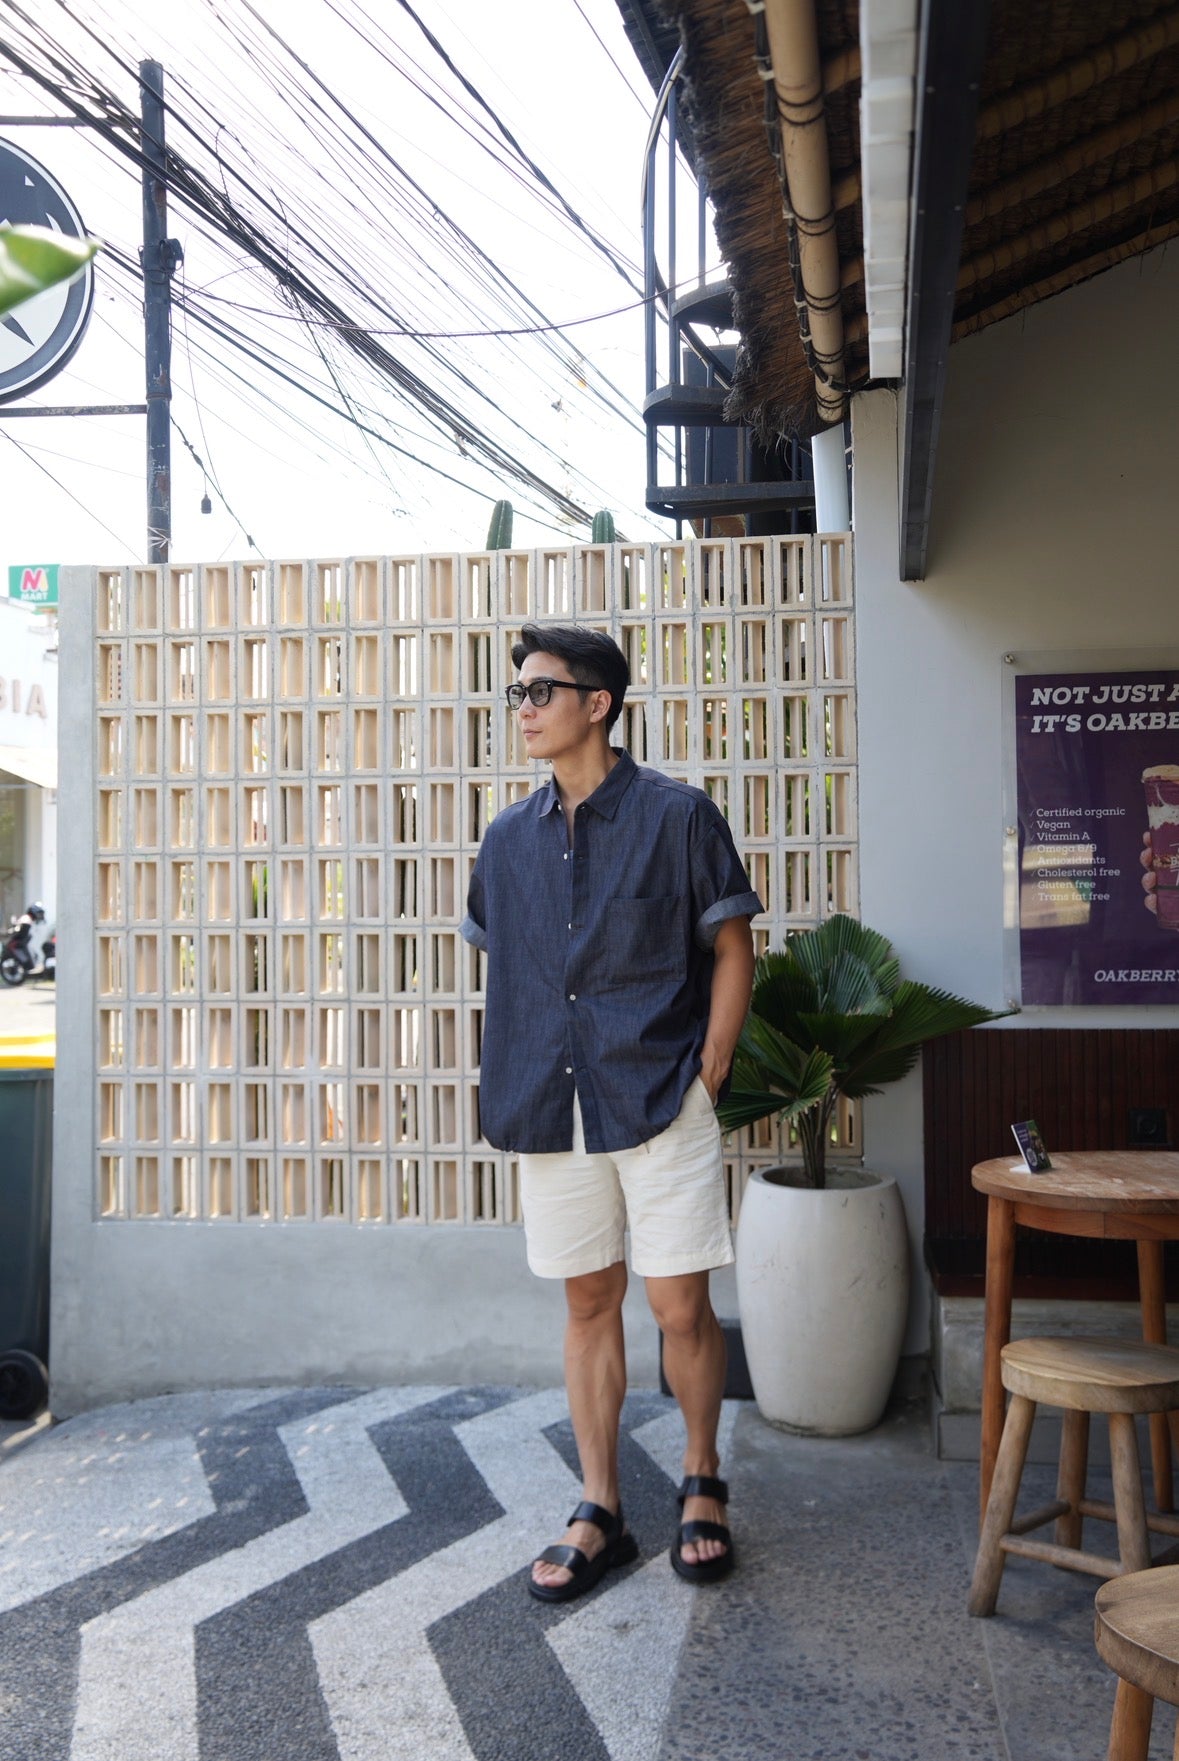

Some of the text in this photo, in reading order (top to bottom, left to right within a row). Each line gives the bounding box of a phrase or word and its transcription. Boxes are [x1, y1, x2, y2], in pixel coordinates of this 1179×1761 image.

[21, 591, 48, 601] MART
[1030, 686, 1090, 706] NOT
[1092, 684, 1166, 704] JUST
[1031, 714, 1082, 733] IT'S
[1036, 807, 1126, 819] Certified organic
[1036, 820, 1071, 832] Vegan
[1036, 831, 1091, 841] Vitamin A
[1036, 844, 1075, 855] Omega
[1037, 856, 1106, 865] Antioxidants
[1037, 867, 1121, 877] Cholesterol free
[1037, 879, 1097, 889] Gluten free
[1038, 891, 1111, 901] Trans fat free
[1094, 969, 1179, 983] OAKBERR
